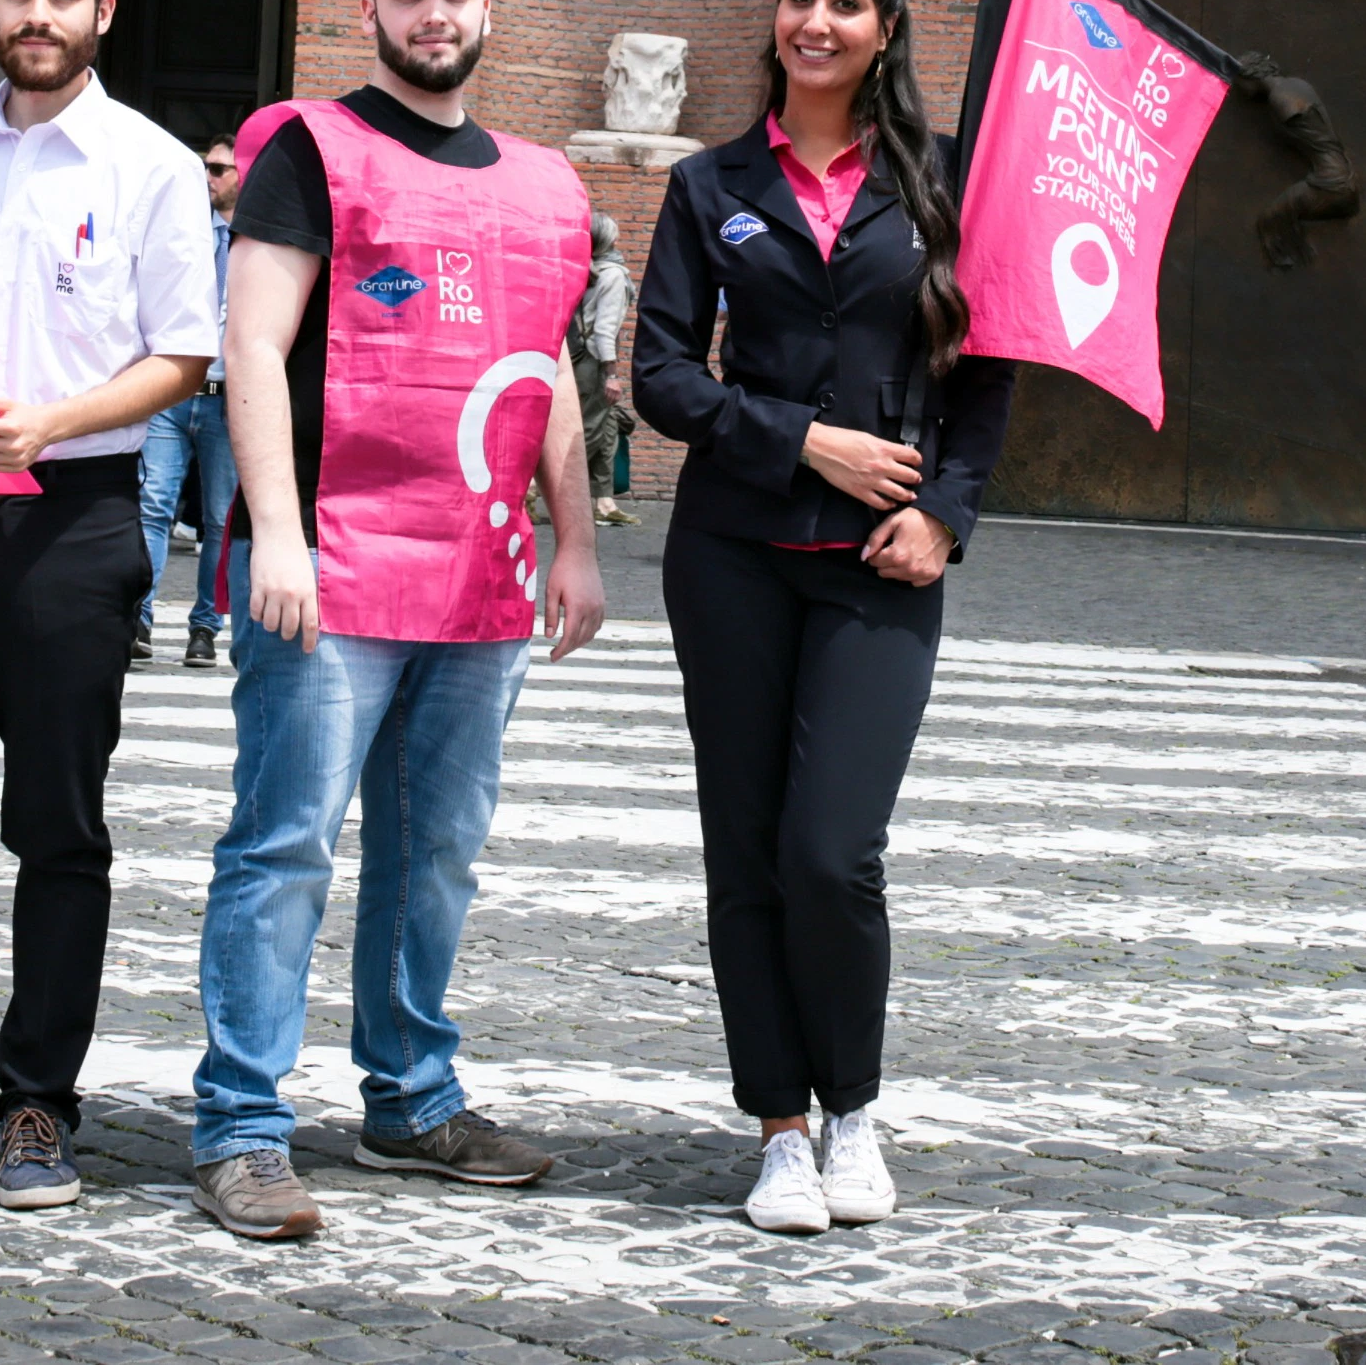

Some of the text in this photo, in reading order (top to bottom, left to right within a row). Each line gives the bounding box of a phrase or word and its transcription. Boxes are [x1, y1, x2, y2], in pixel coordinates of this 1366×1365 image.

[1147, 44, 1162, 66] I
[1137, 67, 1170, 104] Ro
[1133, 91, 1167, 128] me
[1026, 59, 1158, 193] MEETING
[1048, 106, 1142, 205] POINT
[1046, 153, 1136, 234] YOUR TOUR
[1032, 175, 1136, 257] STARTS HERE
[436, 249, 443, 273] I
[56, 285, 74, 295] me
[57, 273, 72, 285] Ro
[361, 280, 394, 292] Gray
[438, 276, 474, 303] Ro
[440, 303, 483, 324] me
